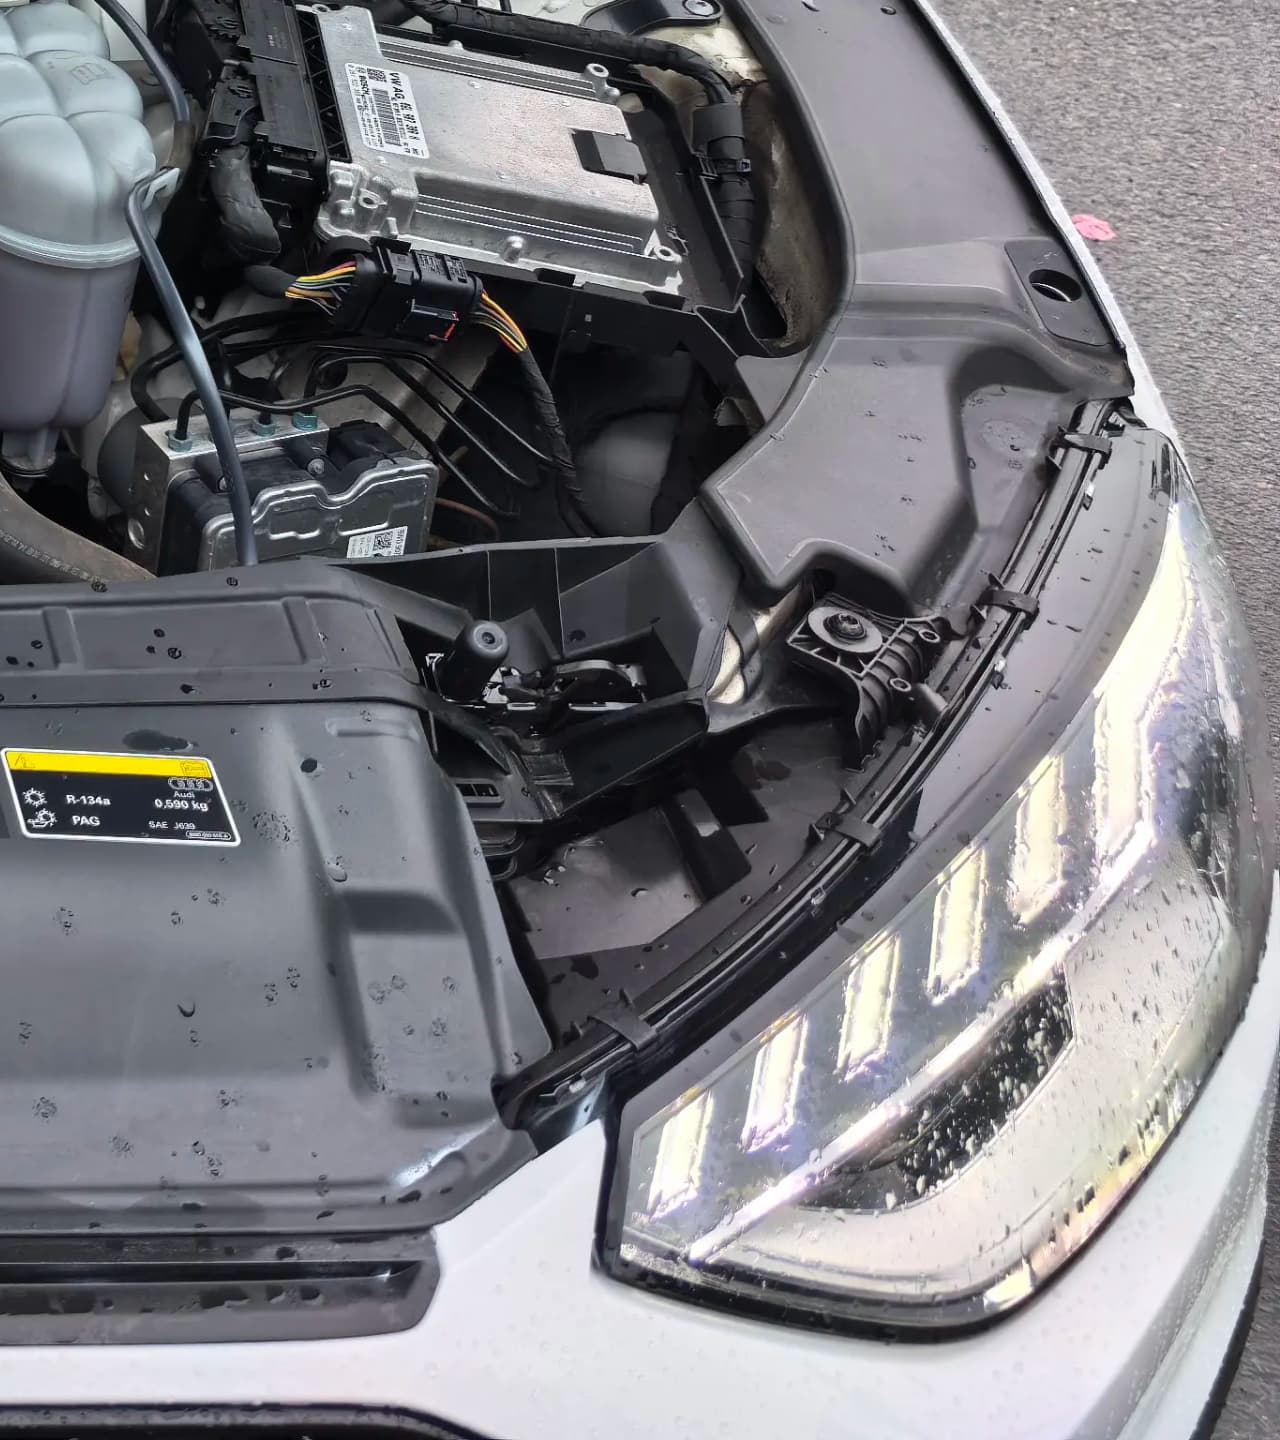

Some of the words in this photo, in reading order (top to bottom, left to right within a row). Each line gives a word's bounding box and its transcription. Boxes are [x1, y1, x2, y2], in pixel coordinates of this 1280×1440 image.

[173, 790, 195, 798] Audi
[66, 794, 111, 806] R-134a
[154, 798, 188, 810] 0,590
[190, 801, 209, 812] kg
[72, 815, 101, 826] PAG
[148, 820, 168, 829] SAE
